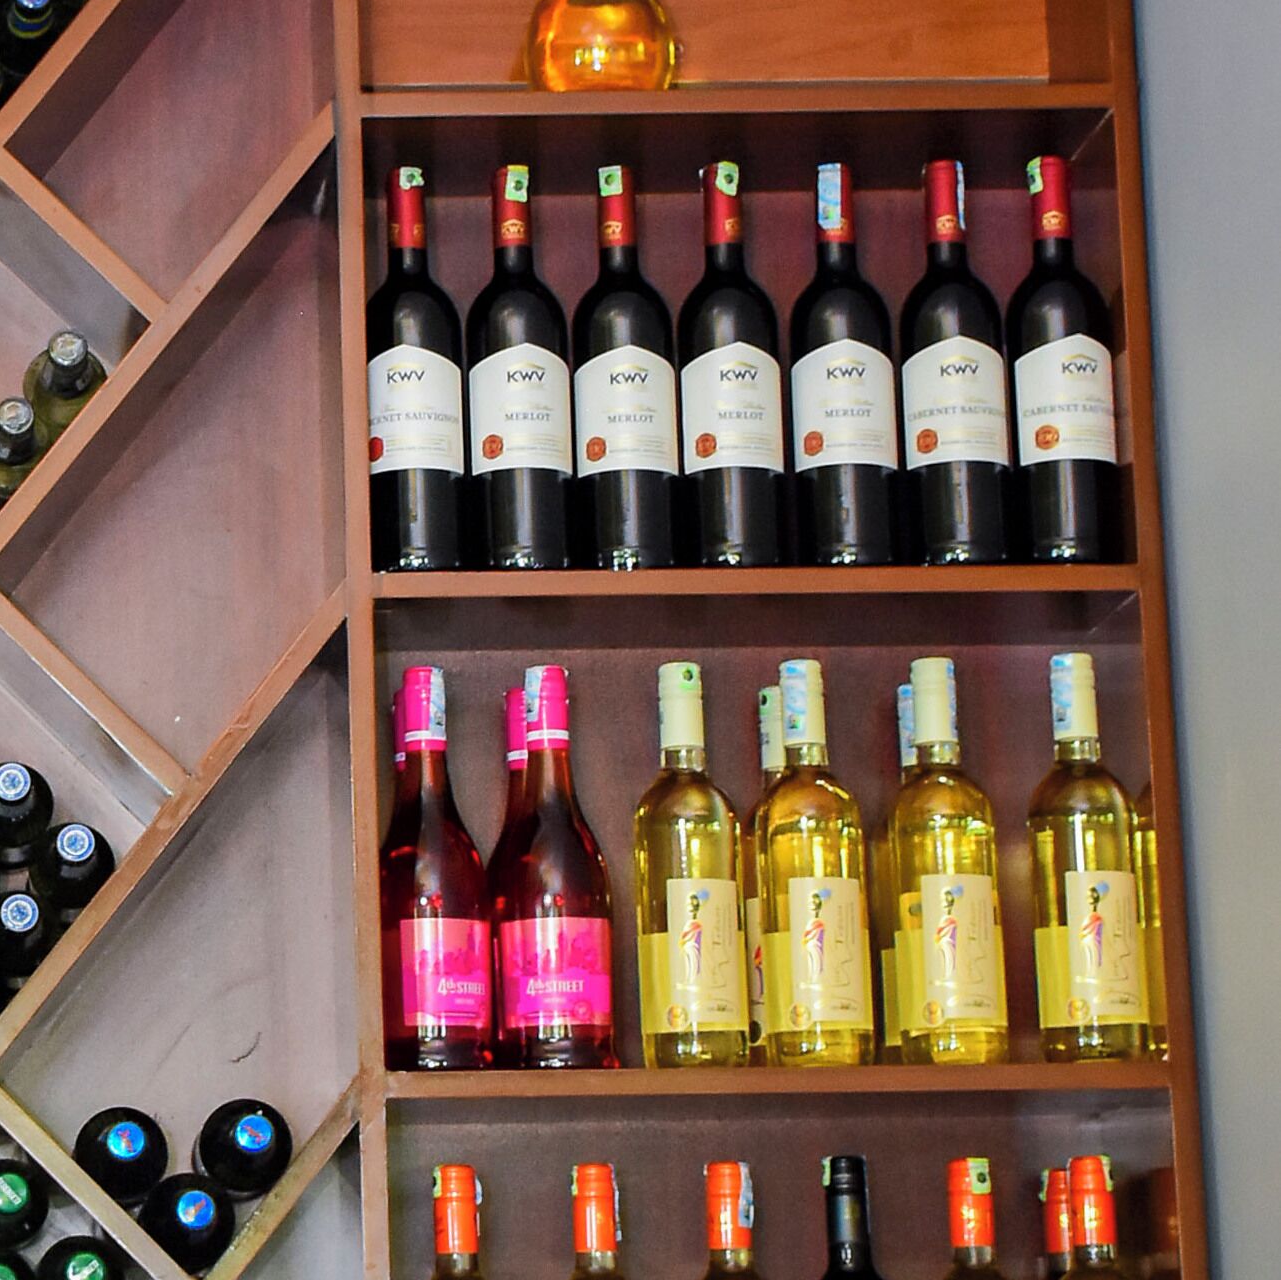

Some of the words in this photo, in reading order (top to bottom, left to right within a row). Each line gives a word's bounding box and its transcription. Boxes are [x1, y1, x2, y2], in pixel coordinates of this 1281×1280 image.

[826, 367, 865, 380] KWV
[940, 364, 979, 377] KWV
[1062, 361, 1098, 374] KWV
[386, 370, 425, 384] KWV
[507, 370, 545, 383] KWV
[610, 372, 648, 385] KWV
[720, 370, 758, 382] KWV
[505, 412, 550, 421] MERLOT
[608, 414, 654, 423] MERLOT
[718, 411, 764, 421] MERLOT
[824, 408, 871, 418] MERLOT
[526, 978, 545, 996] 4th
[545, 979, 584, 993] STREET
